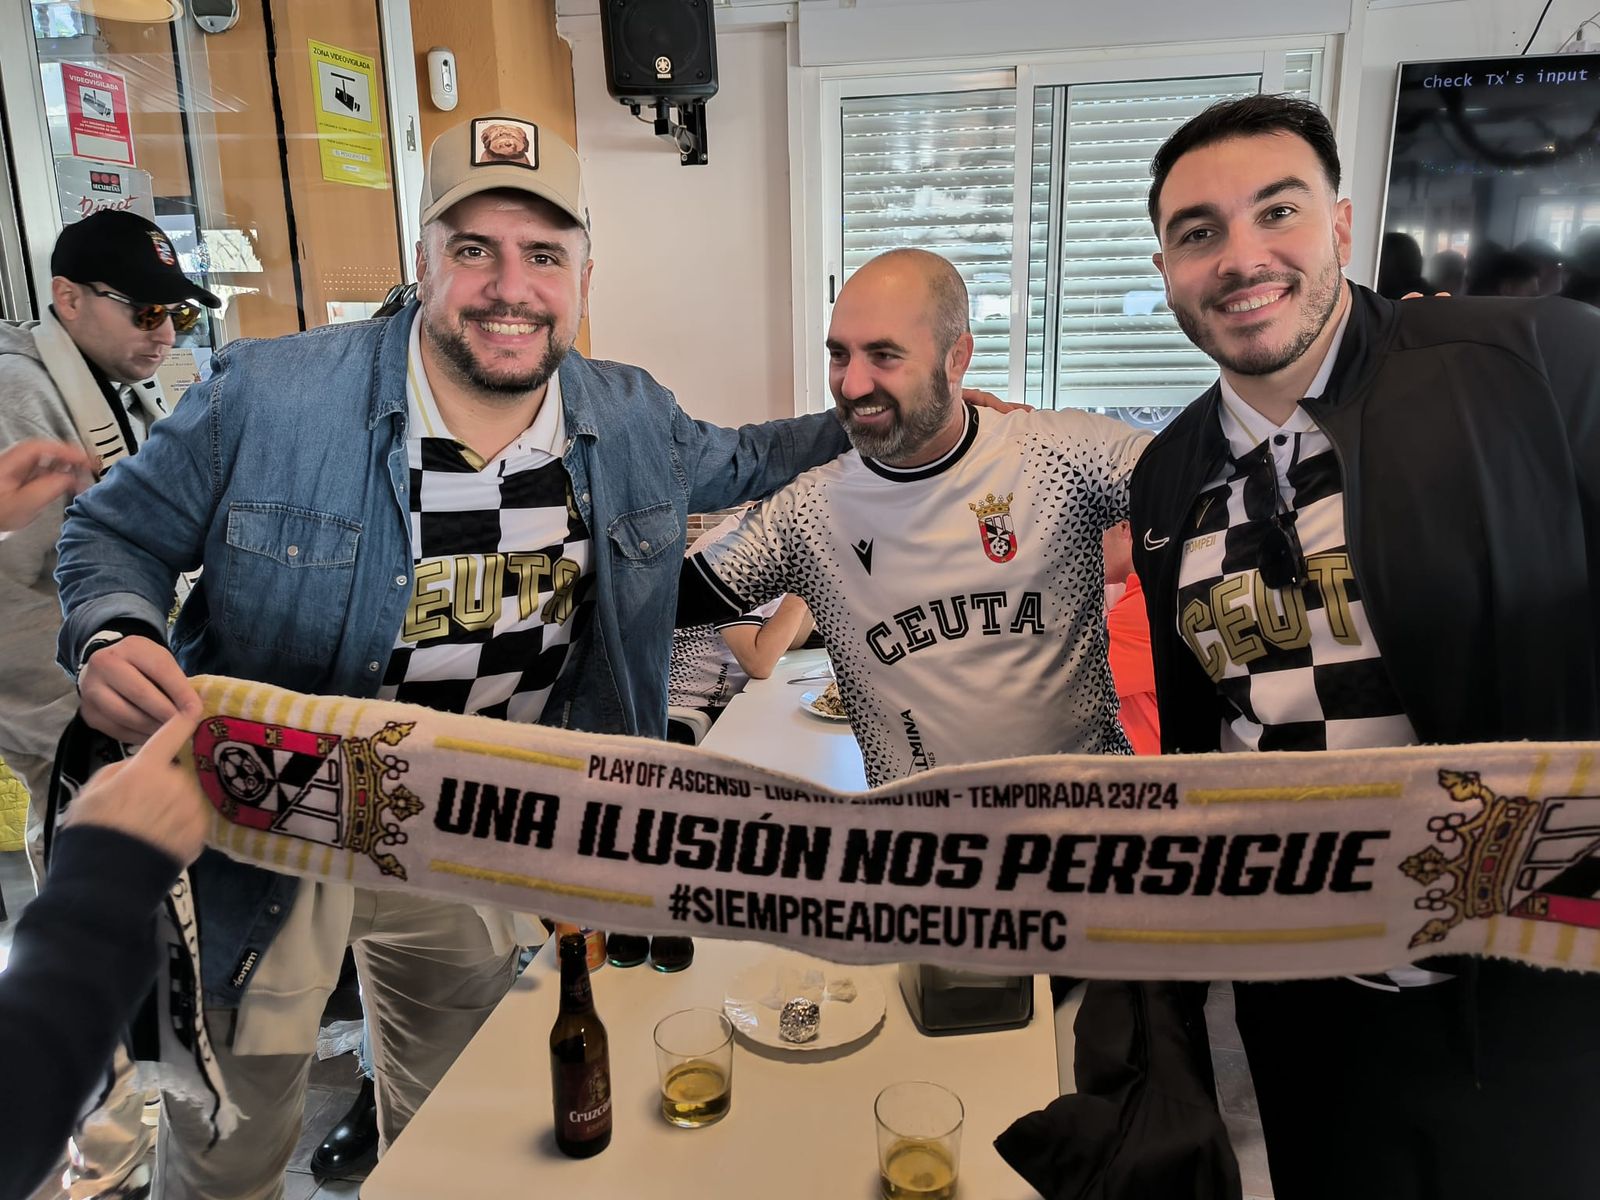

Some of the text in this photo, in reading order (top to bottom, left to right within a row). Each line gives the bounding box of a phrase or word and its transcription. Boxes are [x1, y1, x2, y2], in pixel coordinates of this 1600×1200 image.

[84, 70, 103, 80] ZONA
[313, 47, 371, 70] ZONA VIDEOVIGILADA
[1423, 73, 1473, 89] Check
[1537, 69, 1589, 87] input
[69, 74, 119, 91] VIDEOVIGILADA
[401, 553, 581, 643] EUTA
[1181, 552, 1362, 684] CEUT
[866, 591, 1045, 666] CEUTA
[669, 767, 751, 798] ASCENSO
[968, 782, 1104, 809] TEMPORADA
[1108, 782, 1179, 810] 23/24
[434, 777, 1391, 895] UNA ILUSIÓN NOS PERSIGUE
[669, 884, 1066, 951] #SIEMPREADCEUTAFC
[569, 1096, 611, 1123] Cruzca
